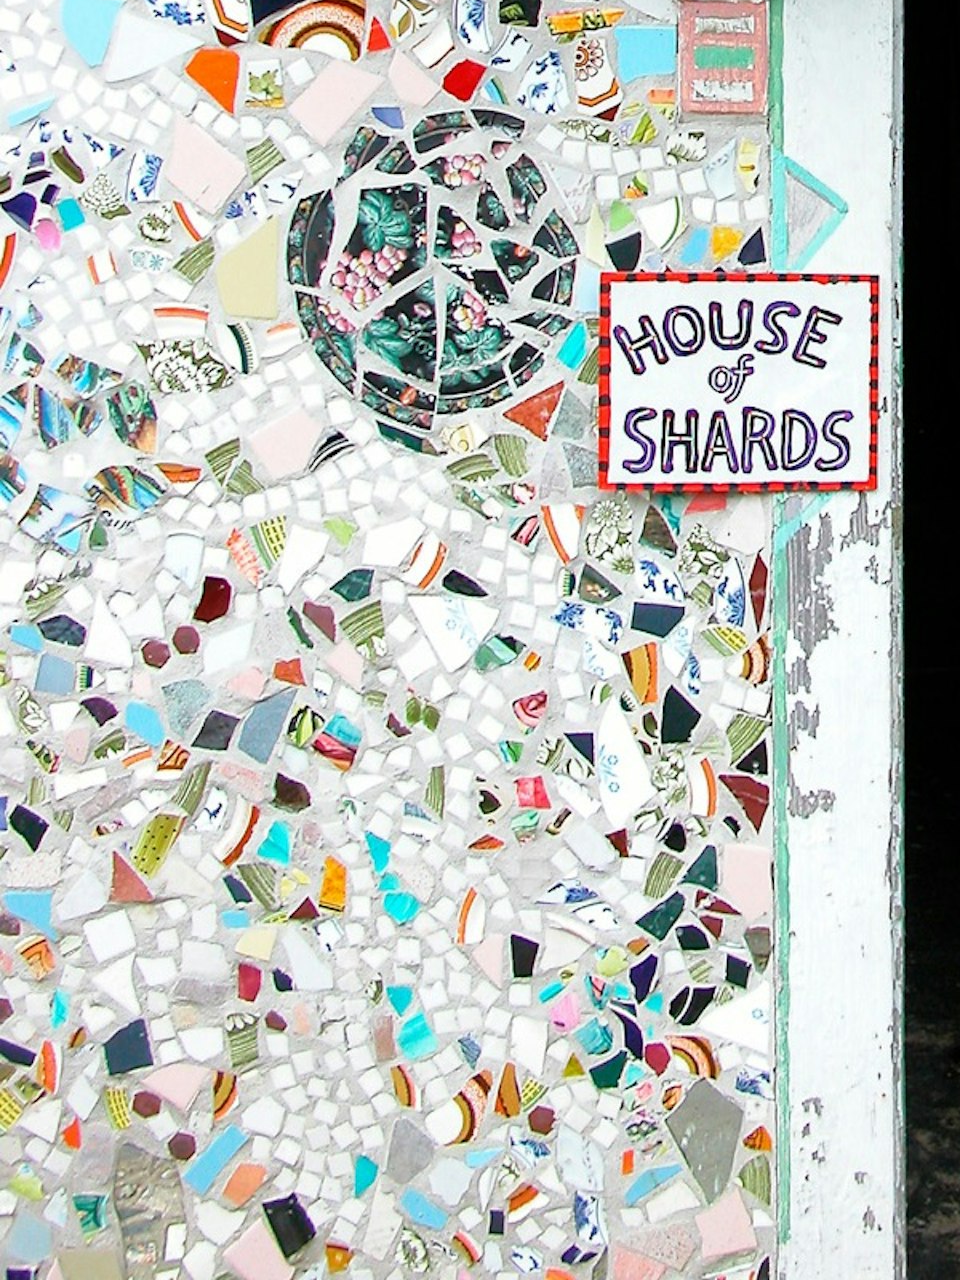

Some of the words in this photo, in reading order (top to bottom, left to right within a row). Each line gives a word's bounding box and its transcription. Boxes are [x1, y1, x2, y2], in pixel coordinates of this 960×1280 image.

[613, 299, 843, 374] HOUSE
[708, 353, 754, 403] of
[622, 406, 855, 473] SHARDS
